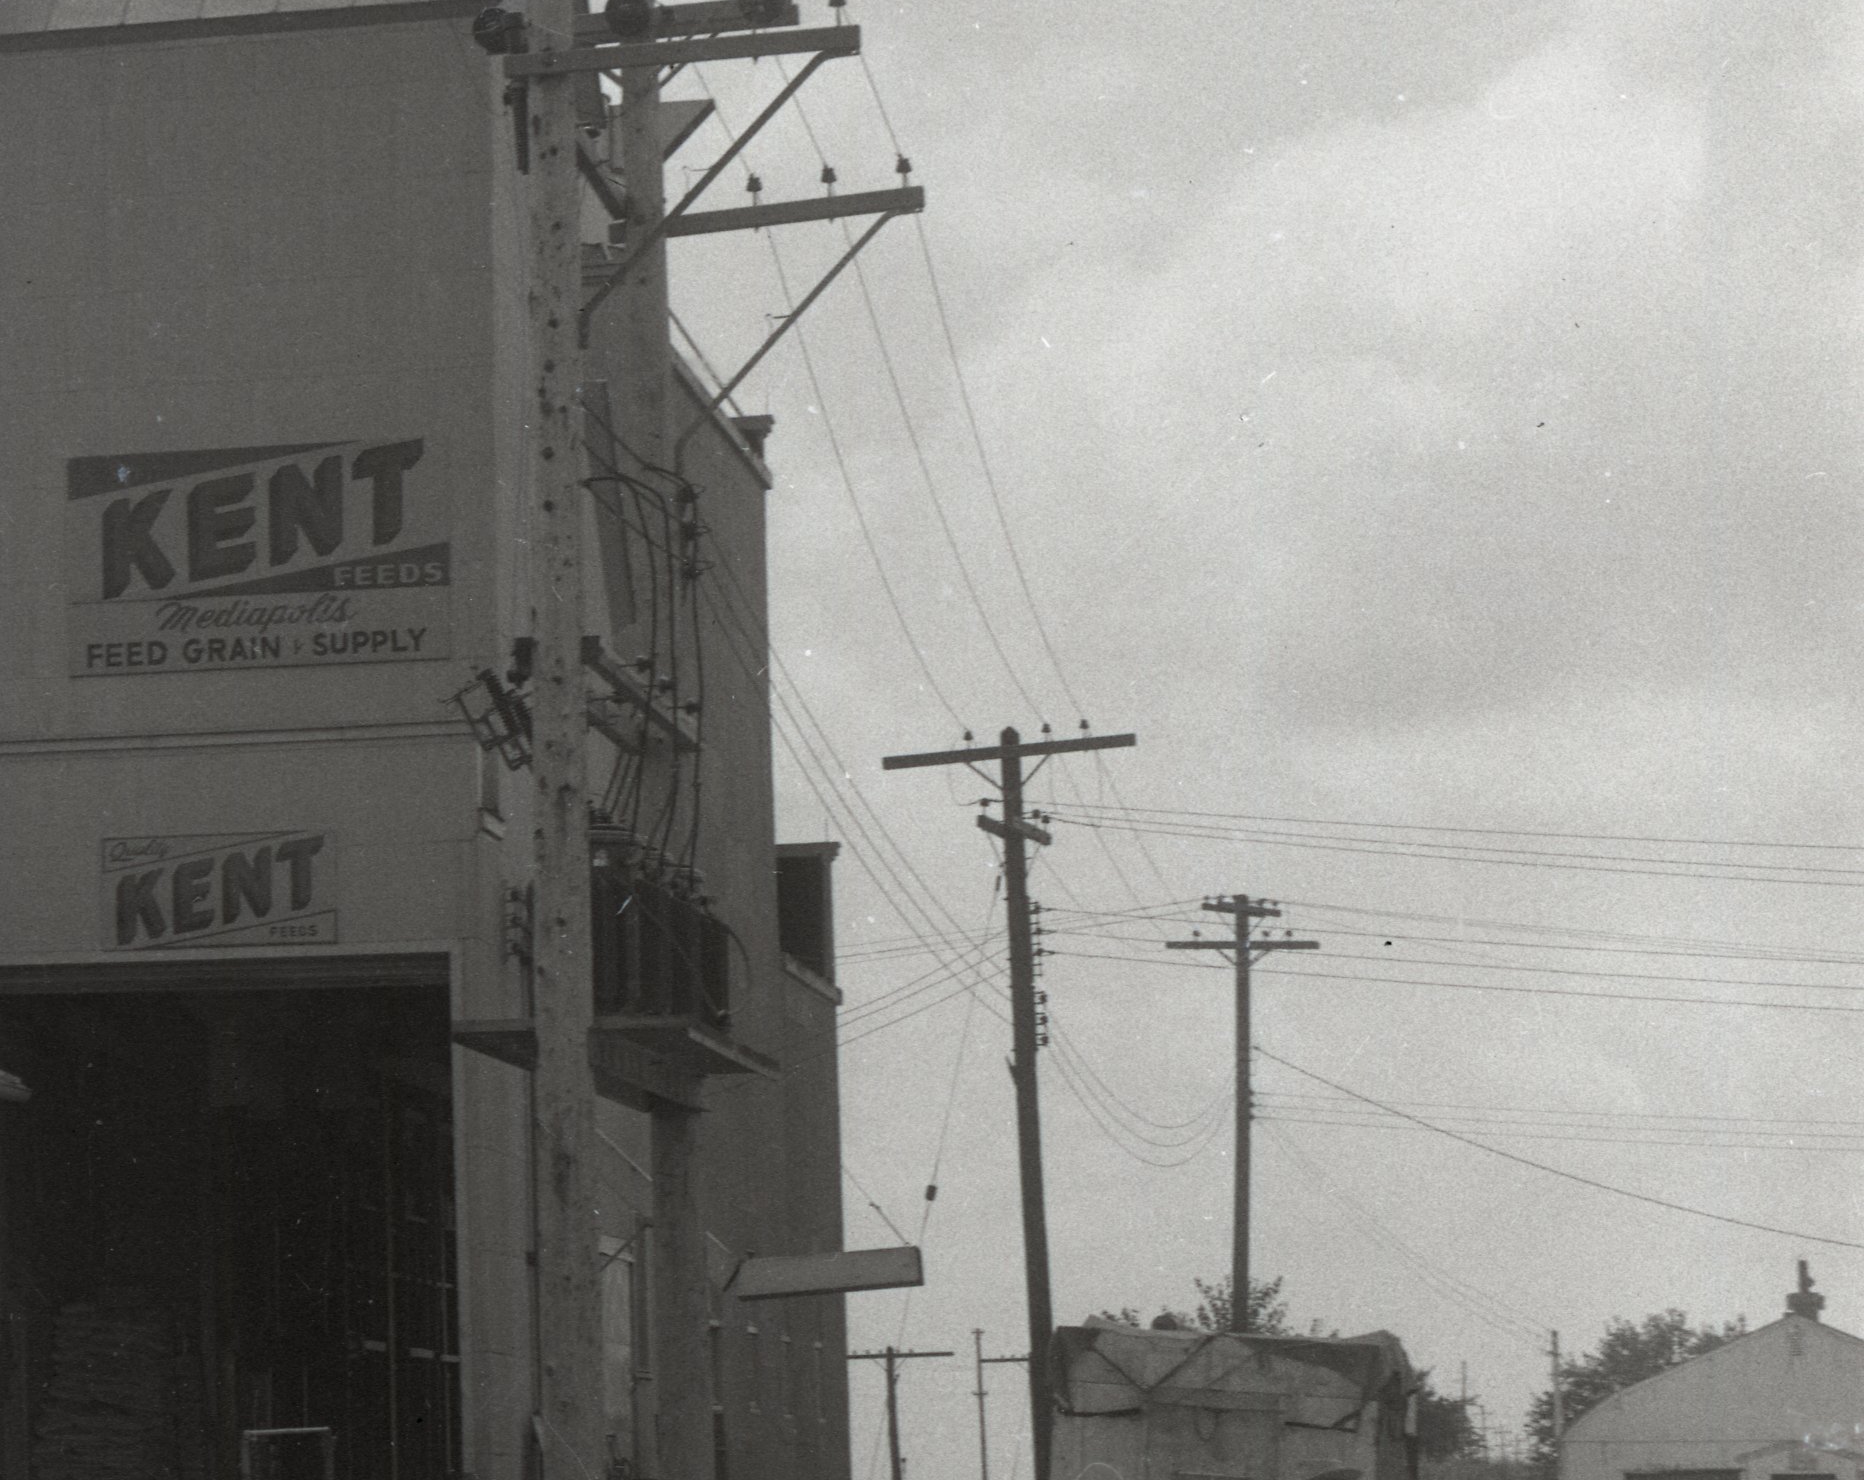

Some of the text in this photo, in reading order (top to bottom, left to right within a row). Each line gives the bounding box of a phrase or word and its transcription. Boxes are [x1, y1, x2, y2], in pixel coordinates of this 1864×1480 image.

[101, 438, 424, 600] KENT
[333, 562, 443, 587] FEEDS
[155, 592, 357, 633] Mediapolis
[86, 640, 168, 668] FEED
[182, 635, 280, 664] GRAIN
[311, 627, 427, 657] SUPPLY
[116, 834, 325, 946] KENT
[269, 924, 318, 937] FEEDS
